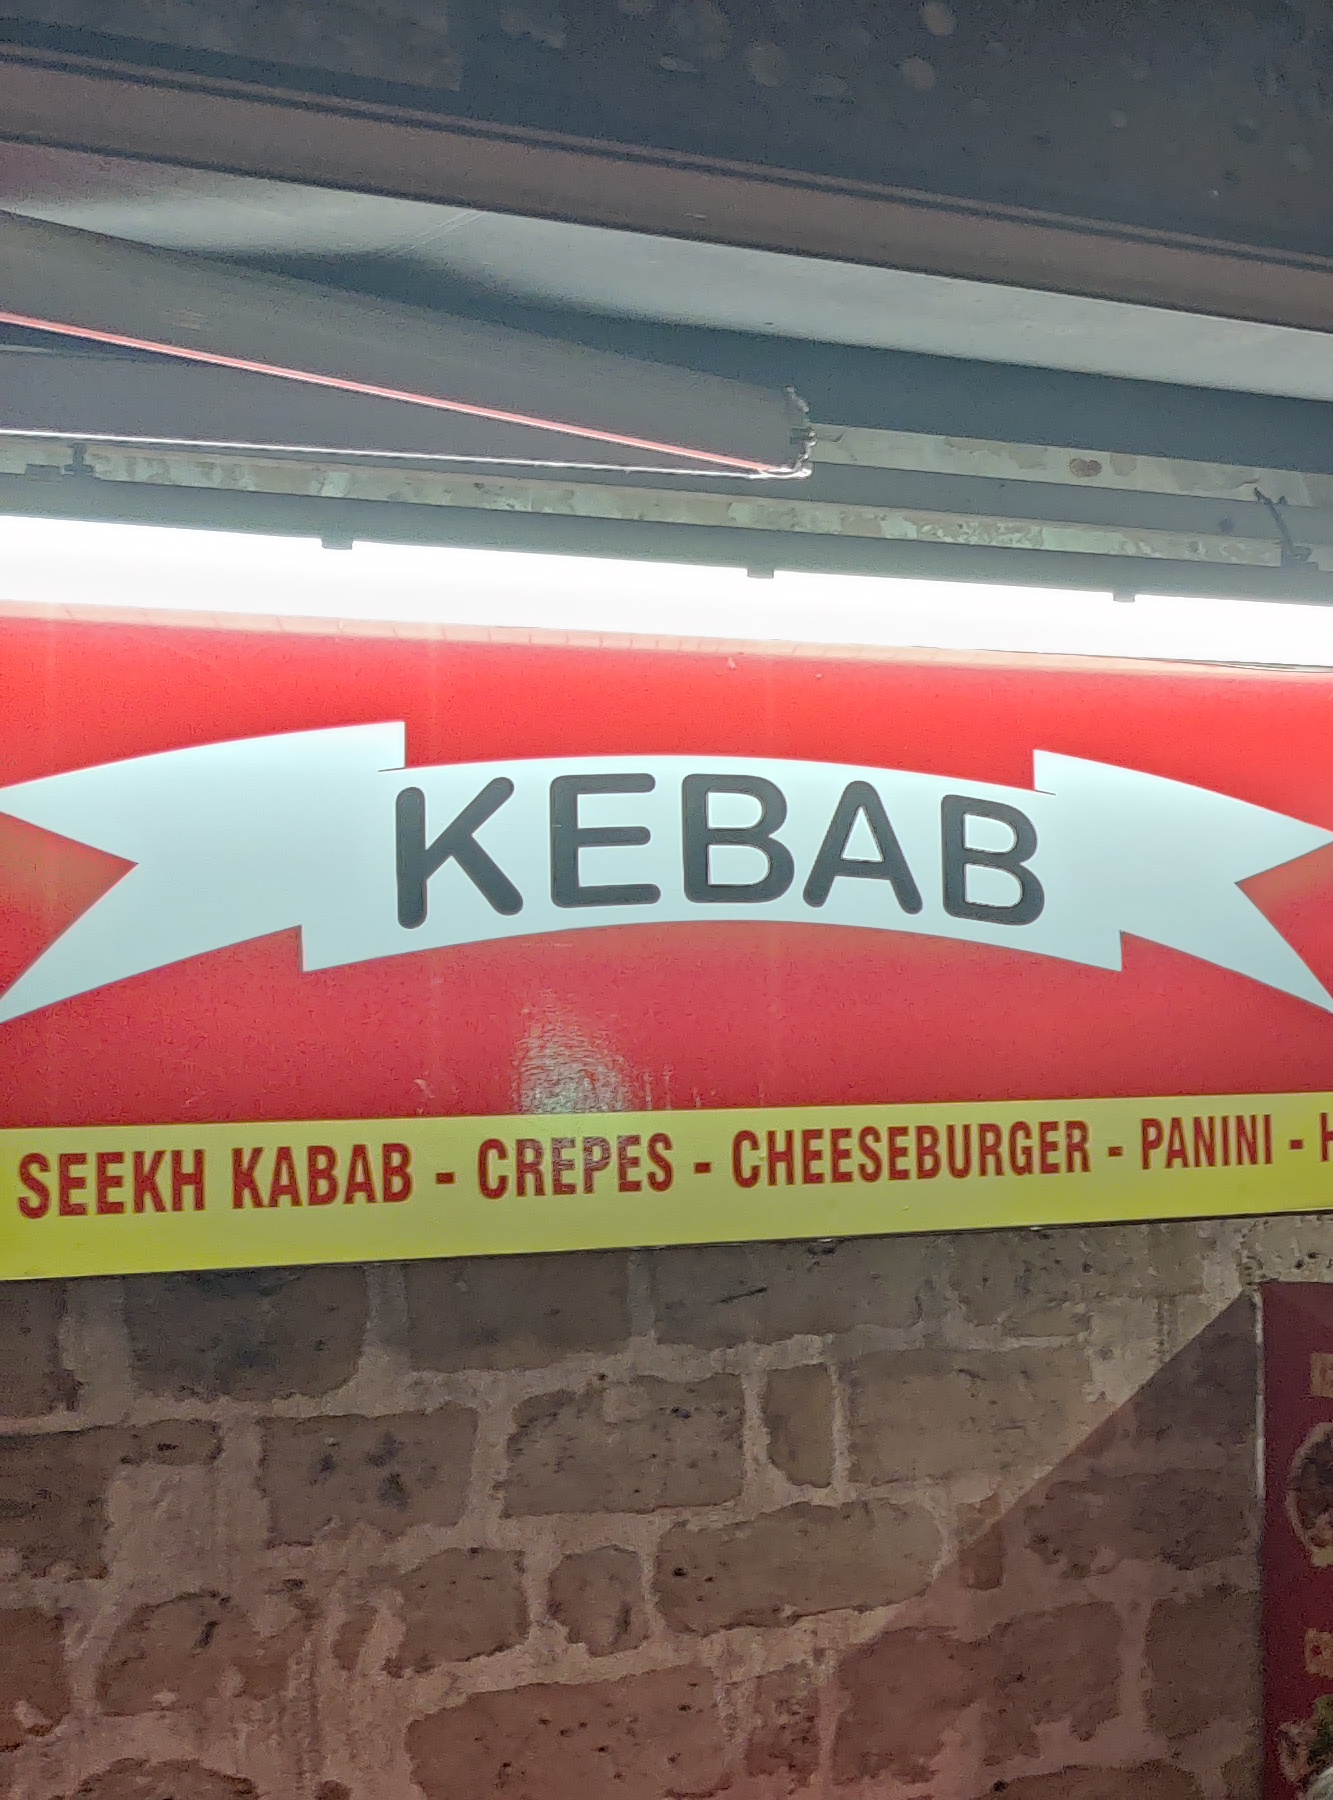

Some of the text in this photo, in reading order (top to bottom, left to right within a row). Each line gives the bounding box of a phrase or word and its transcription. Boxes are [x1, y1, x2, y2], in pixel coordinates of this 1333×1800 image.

[395, 773, 1045, 929] KEBAB
[17, 1148, 206, 1219] SEEKH
[231, 1143, 413, 1209] KABAB
[477, 1132, 673, 1201] CREPES
[732, 1120, 1091, 1189] CHEESEBURGER
[1141, 1114, 1273, 1171] PANINI
